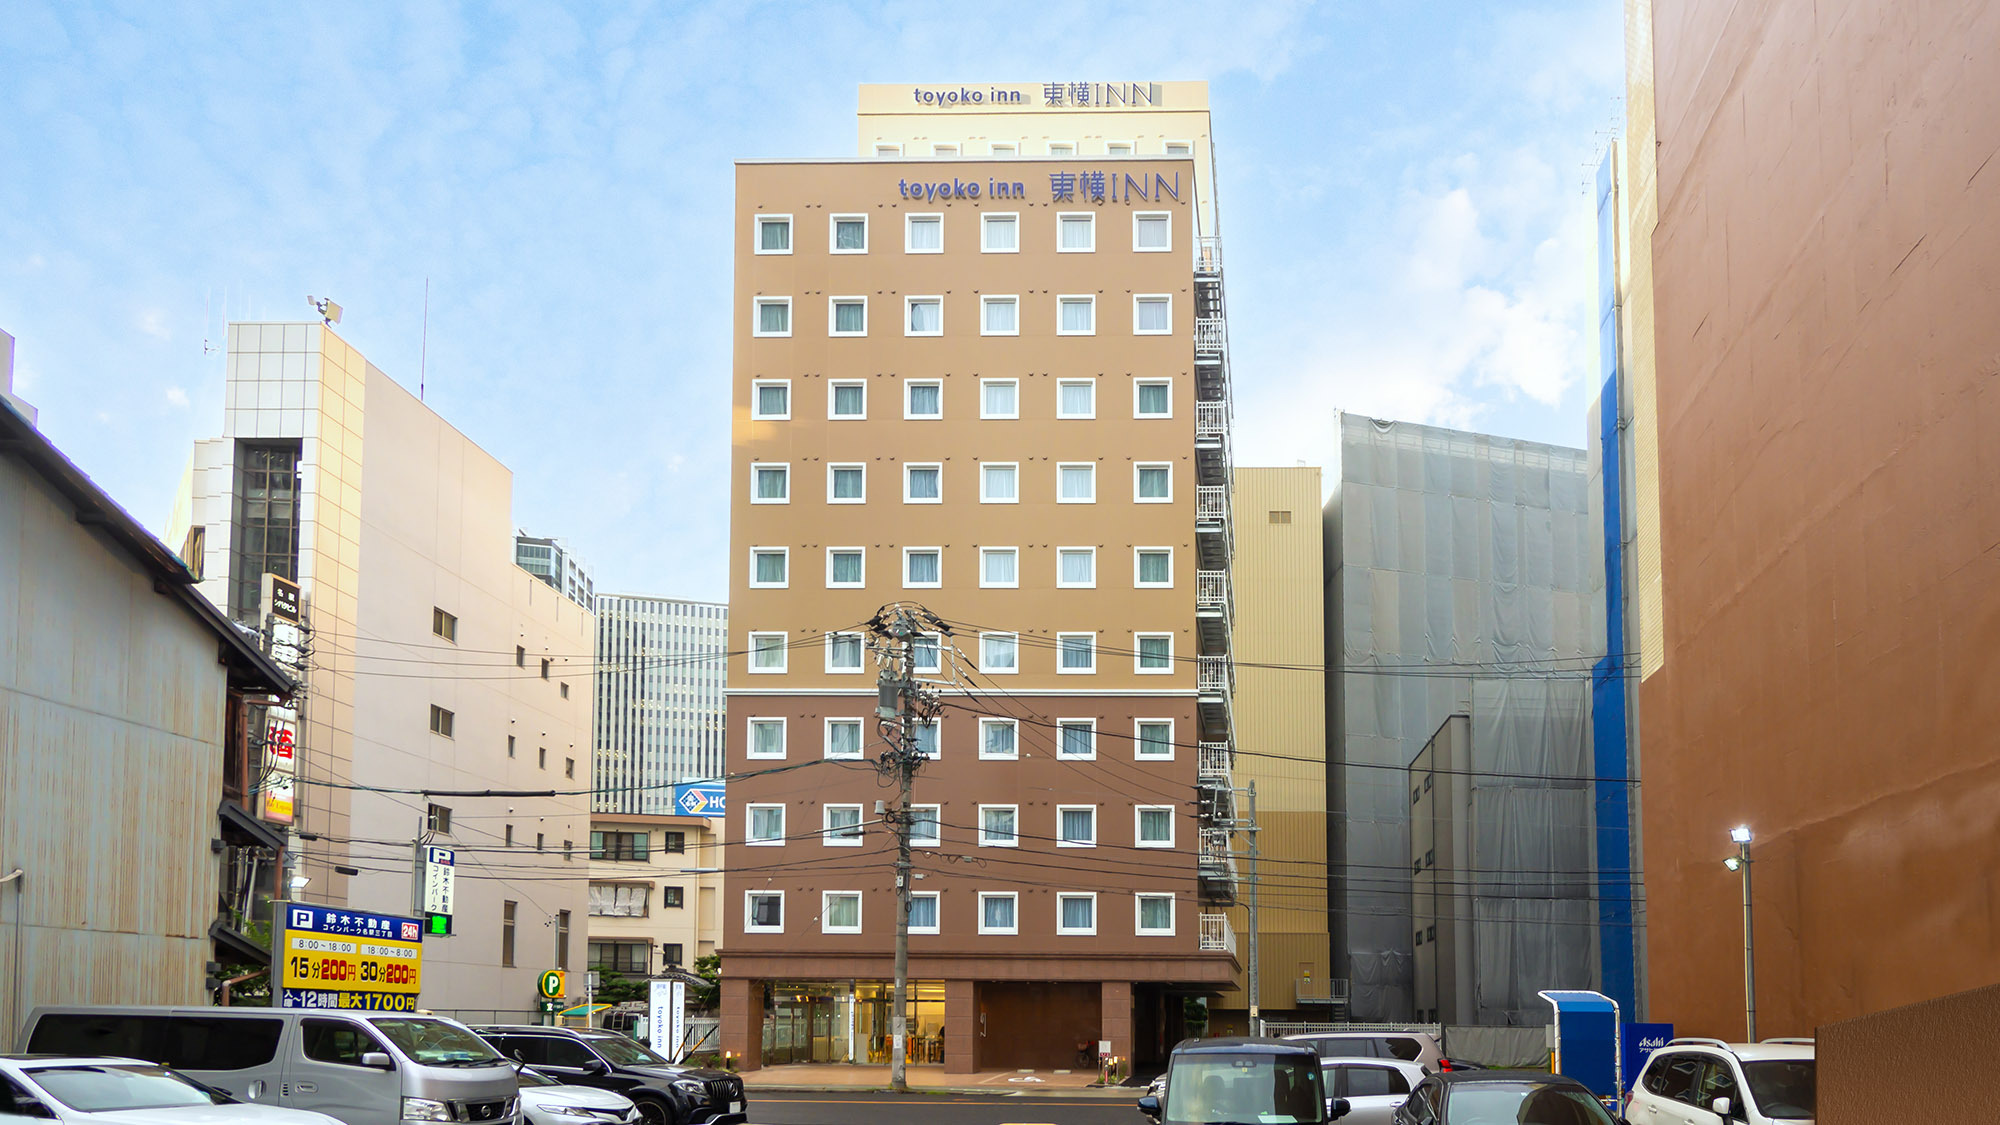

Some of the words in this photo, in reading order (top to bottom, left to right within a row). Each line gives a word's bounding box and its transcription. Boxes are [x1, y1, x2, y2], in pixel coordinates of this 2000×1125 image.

[914, 88, 983, 107] toyoko
[991, 87, 1021, 102] inn
[1043, 82, 1152, 106] 東横INN
[899, 178, 980, 203] toyoko
[989, 177, 1025, 199] inn
[1049, 171, 1179, 202] 東横INN
[431, 866, 439, 911] コインパーク
[442, 868, 450, 913] 鈴木不動産
[326, 913, 391, 930] 鈴木不動産
[402, 924, 418, 939] 24h
[548, 976, 558, 994] P
[1638, 1037, 1664, 1047] Asahi
